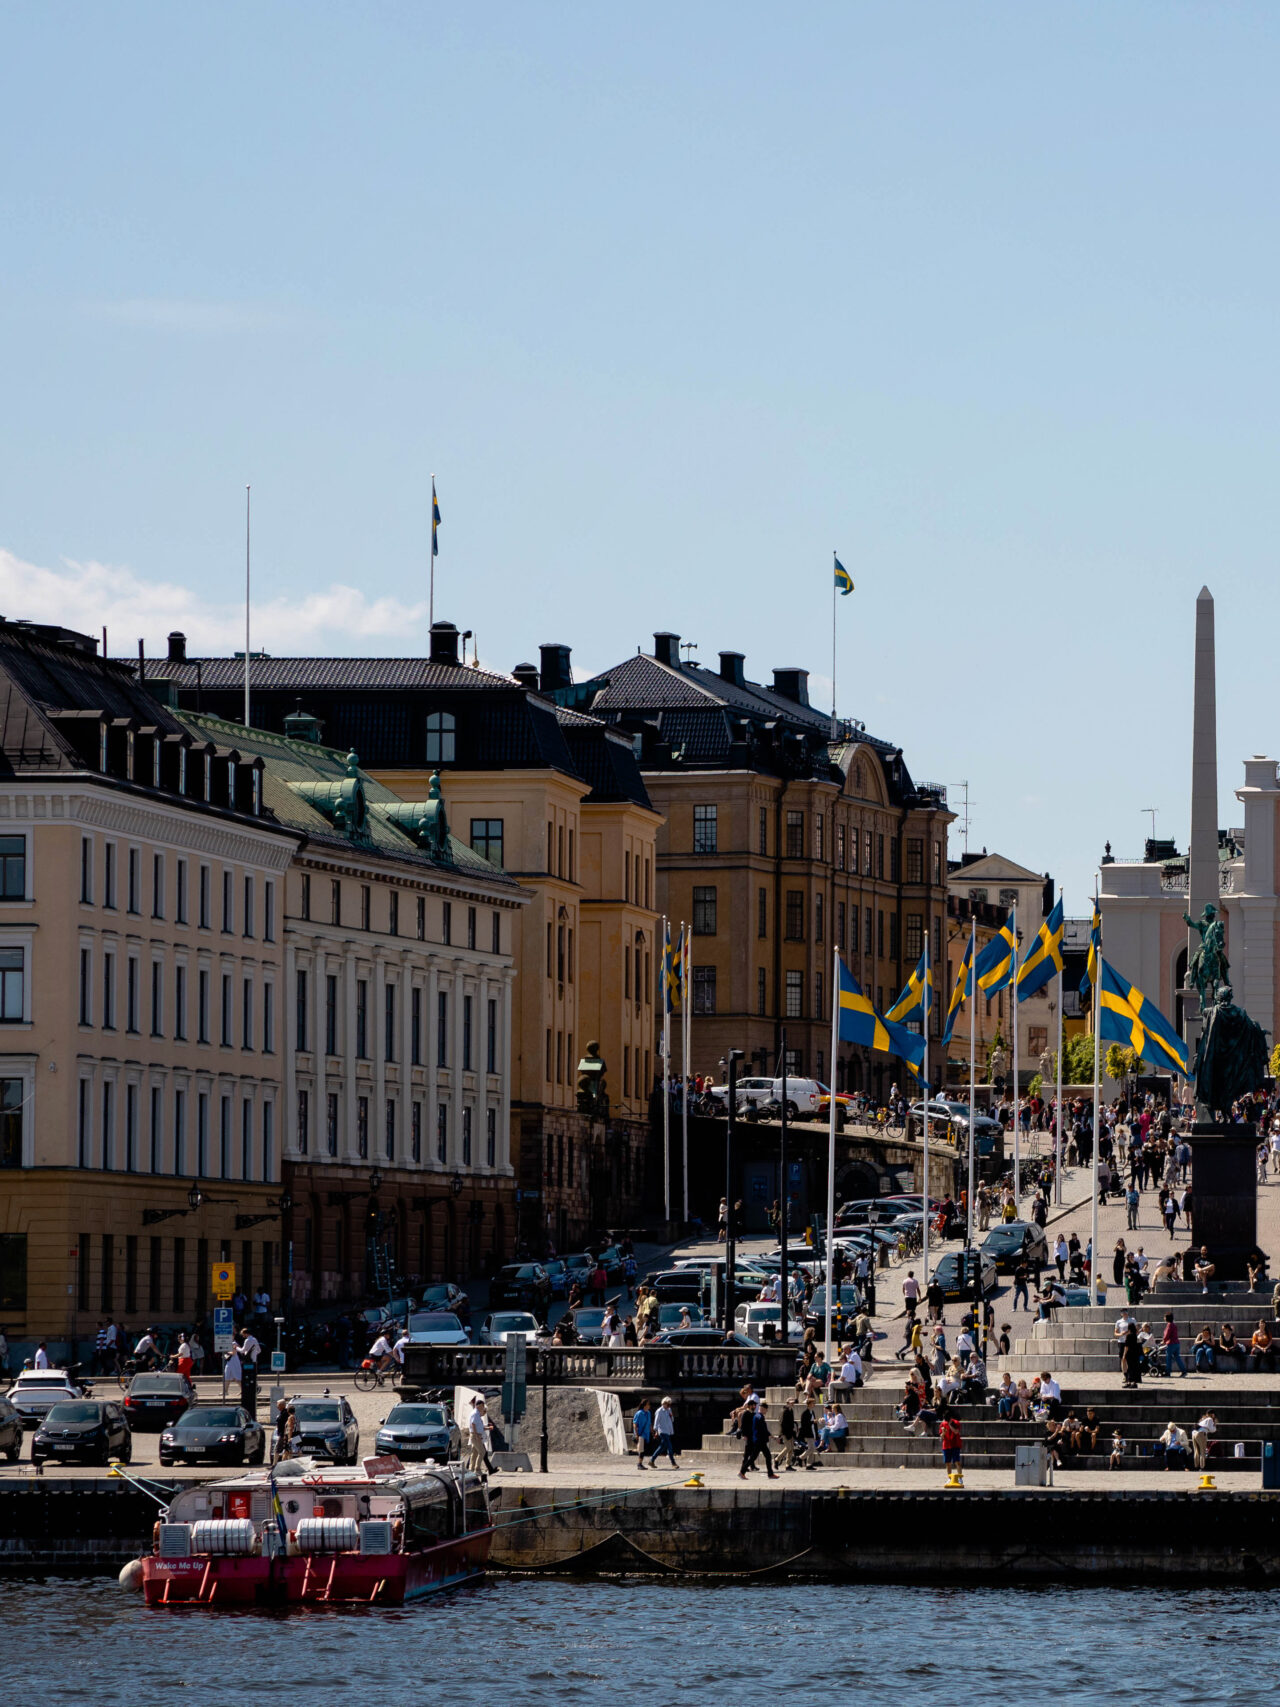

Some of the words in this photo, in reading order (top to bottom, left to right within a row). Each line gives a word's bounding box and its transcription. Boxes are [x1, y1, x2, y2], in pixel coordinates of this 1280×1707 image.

[219, 1310, 228, 1322] P
[155, 1562, 177, 1570] Wake
[178, 1562, 191, 1570] Me
[193, 1561, 204, 1571] Up
